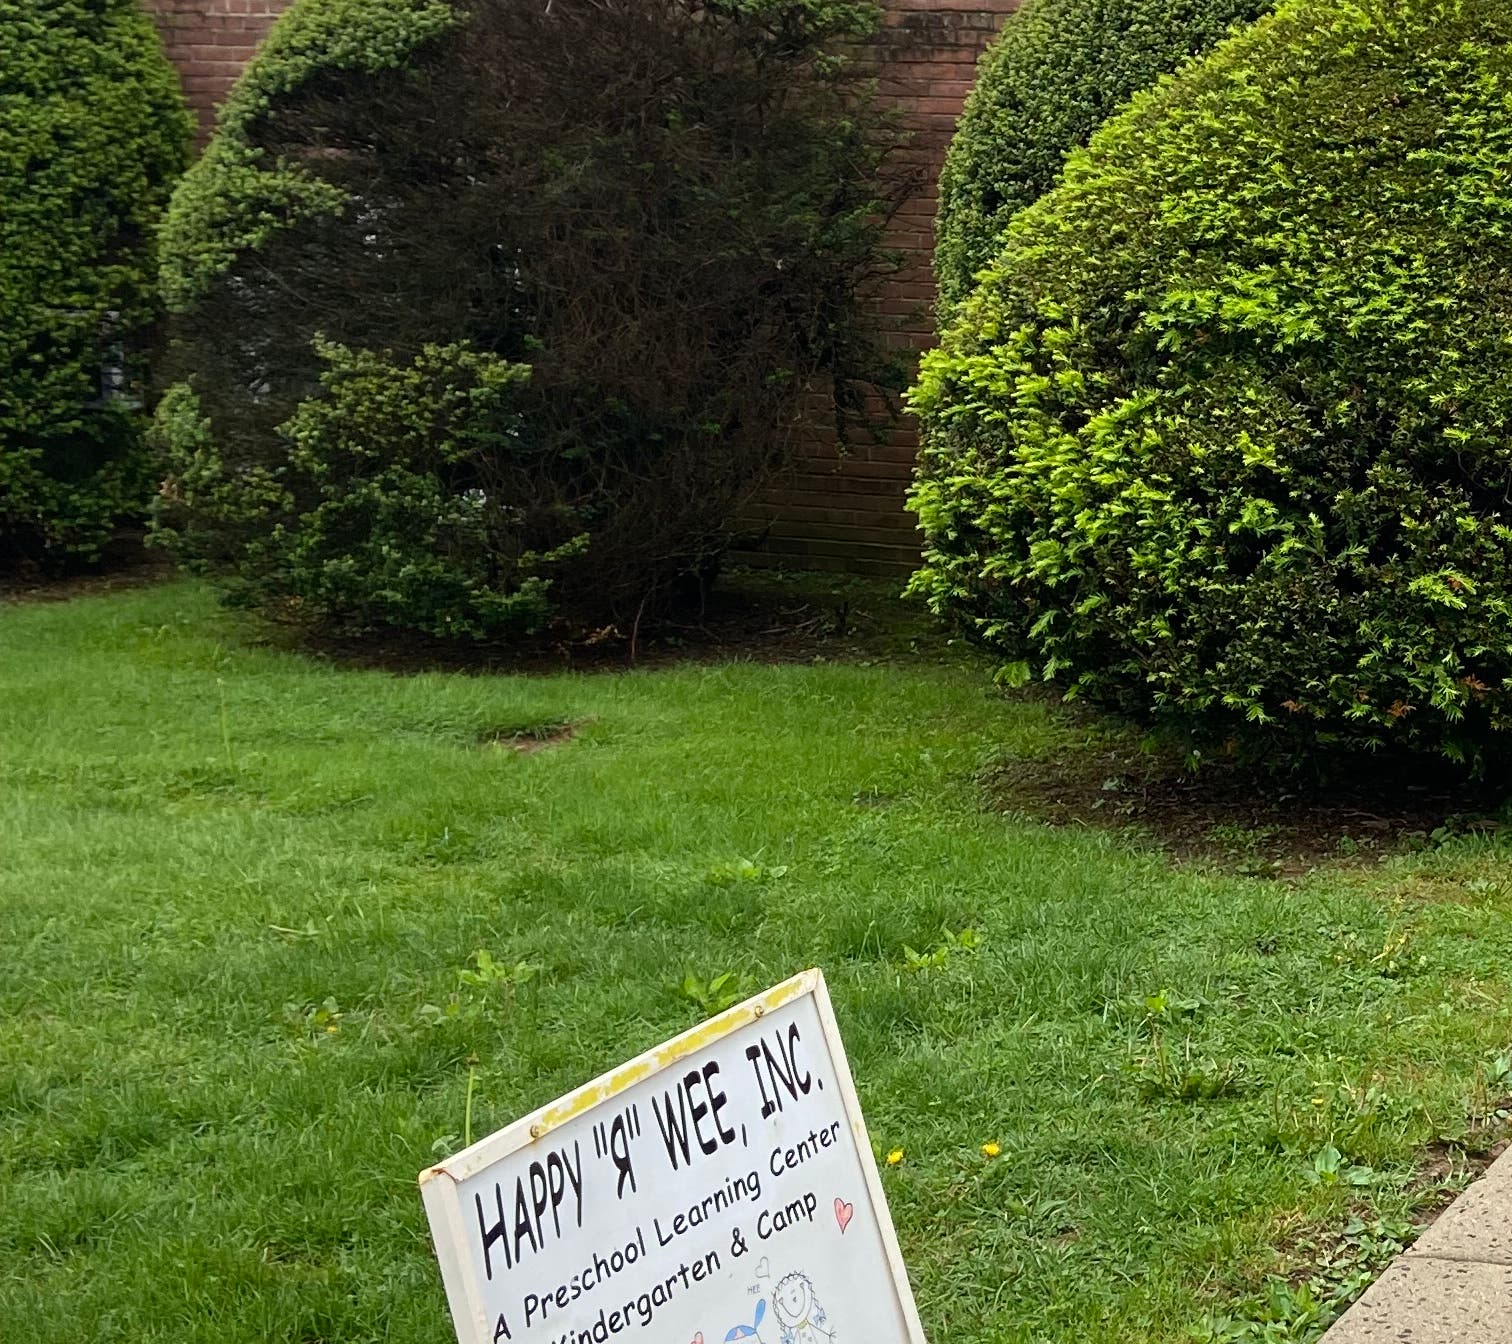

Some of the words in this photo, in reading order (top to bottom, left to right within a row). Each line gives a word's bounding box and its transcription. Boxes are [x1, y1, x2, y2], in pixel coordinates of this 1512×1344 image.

[475, 1140, 582, 1280] HAPPY
[652, 1060, 749, 1172] WEE,
[745, 1022, 823, 1119] INC.
[524, 1227, 647, 1329] Preschool
[653, 1170, 762, 1247] Learning
[770, 1120, 842, 1176] Center
[731, 1228, 749, 1256] &
[757, 1188, 818, 1244] Camp
